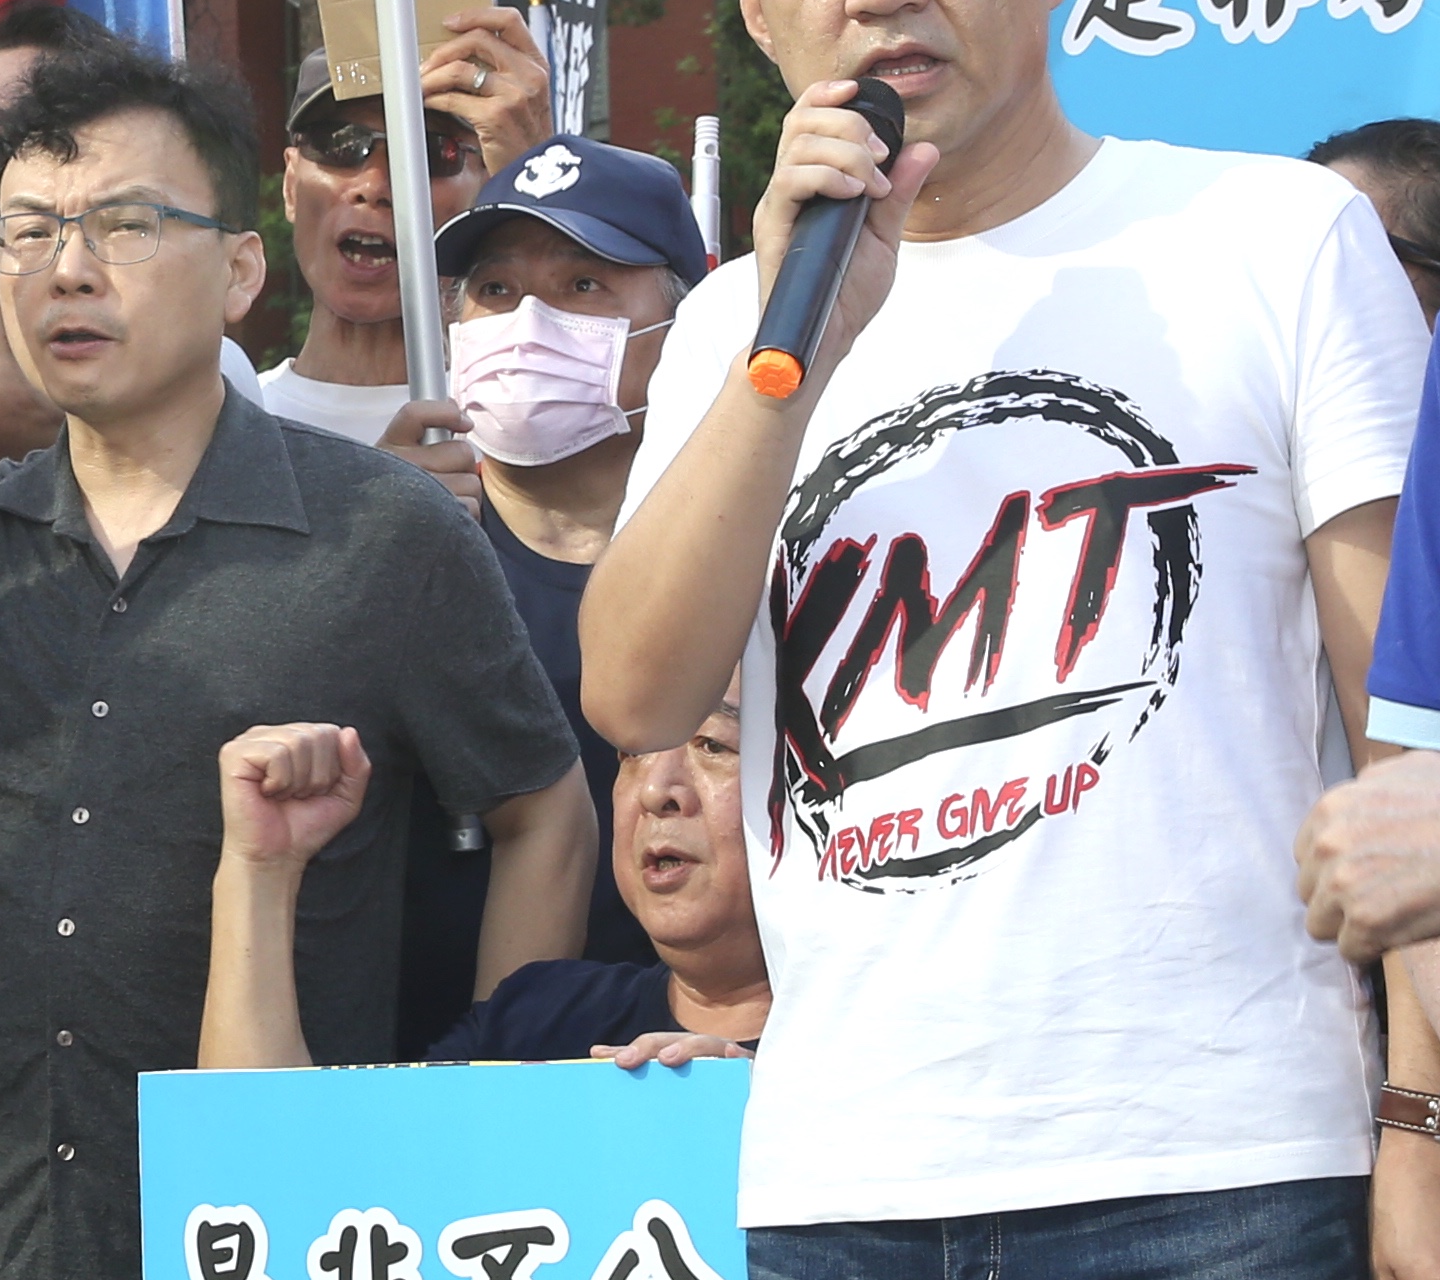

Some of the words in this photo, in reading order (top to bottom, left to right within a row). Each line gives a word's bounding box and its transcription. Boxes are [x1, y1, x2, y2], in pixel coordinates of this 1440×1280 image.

[769, 463, 1258, 835] KMT
[818, 806, 924, 882] NEVER
[937, 776, 1030, 842] GIVE
[1044, 762, 1100, 815] UP
